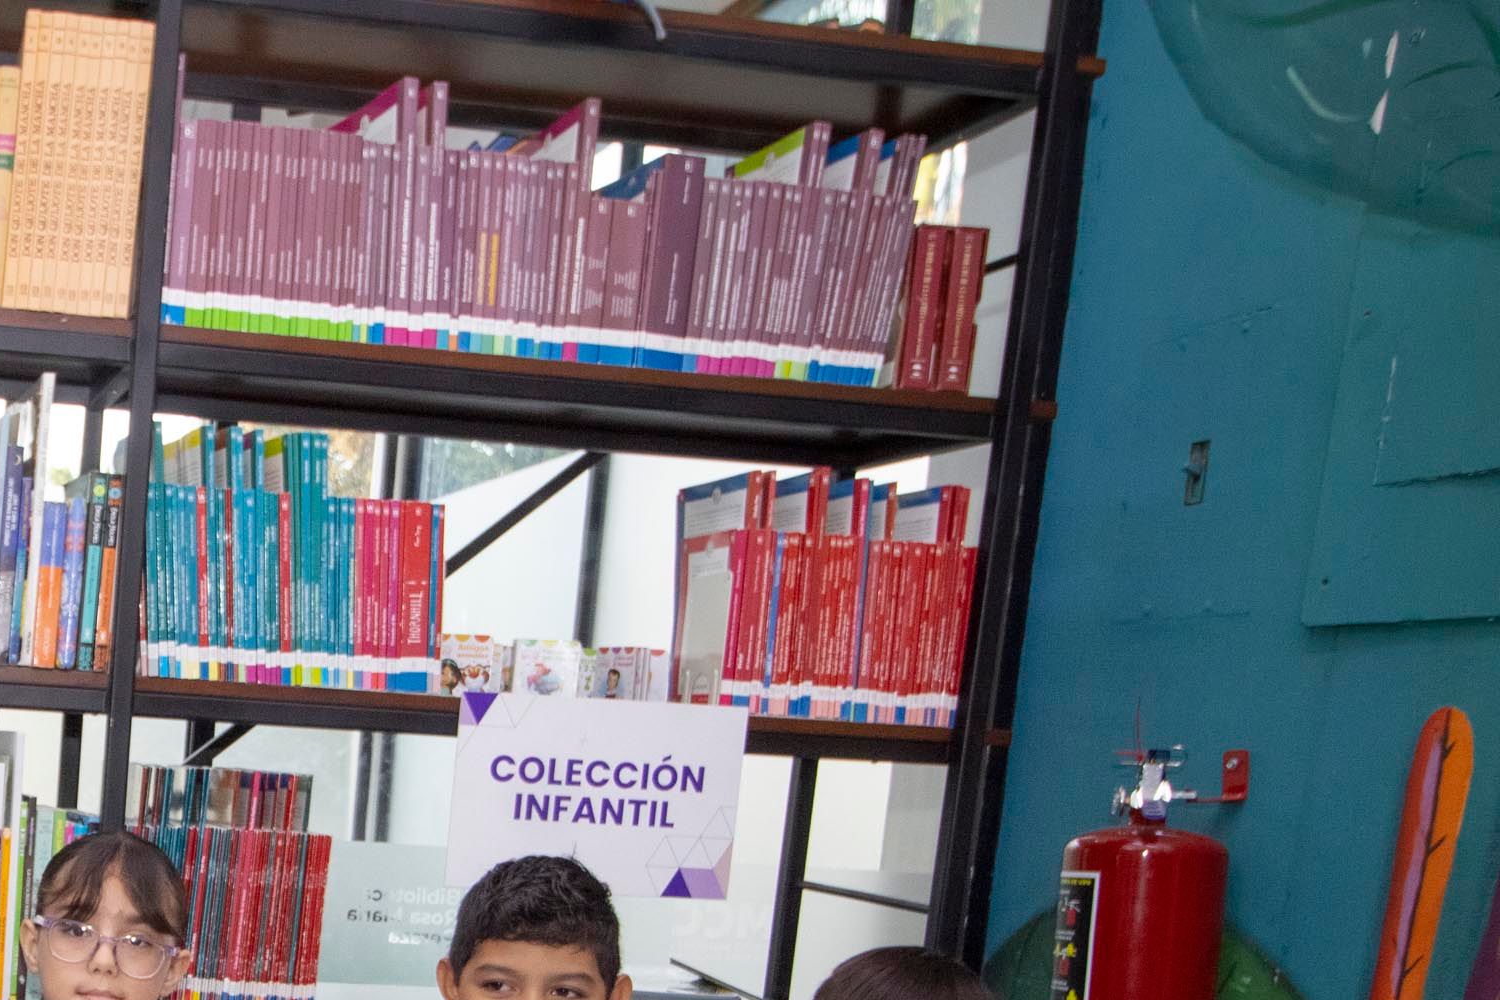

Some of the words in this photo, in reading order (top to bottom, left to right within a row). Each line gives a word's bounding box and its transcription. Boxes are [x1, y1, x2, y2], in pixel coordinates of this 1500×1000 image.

[408, 590, 424, 644] THORNHILL
[490, 755, 706, 793] COLECCIÓN
[513, 793, 675, 829] INFANTIL
